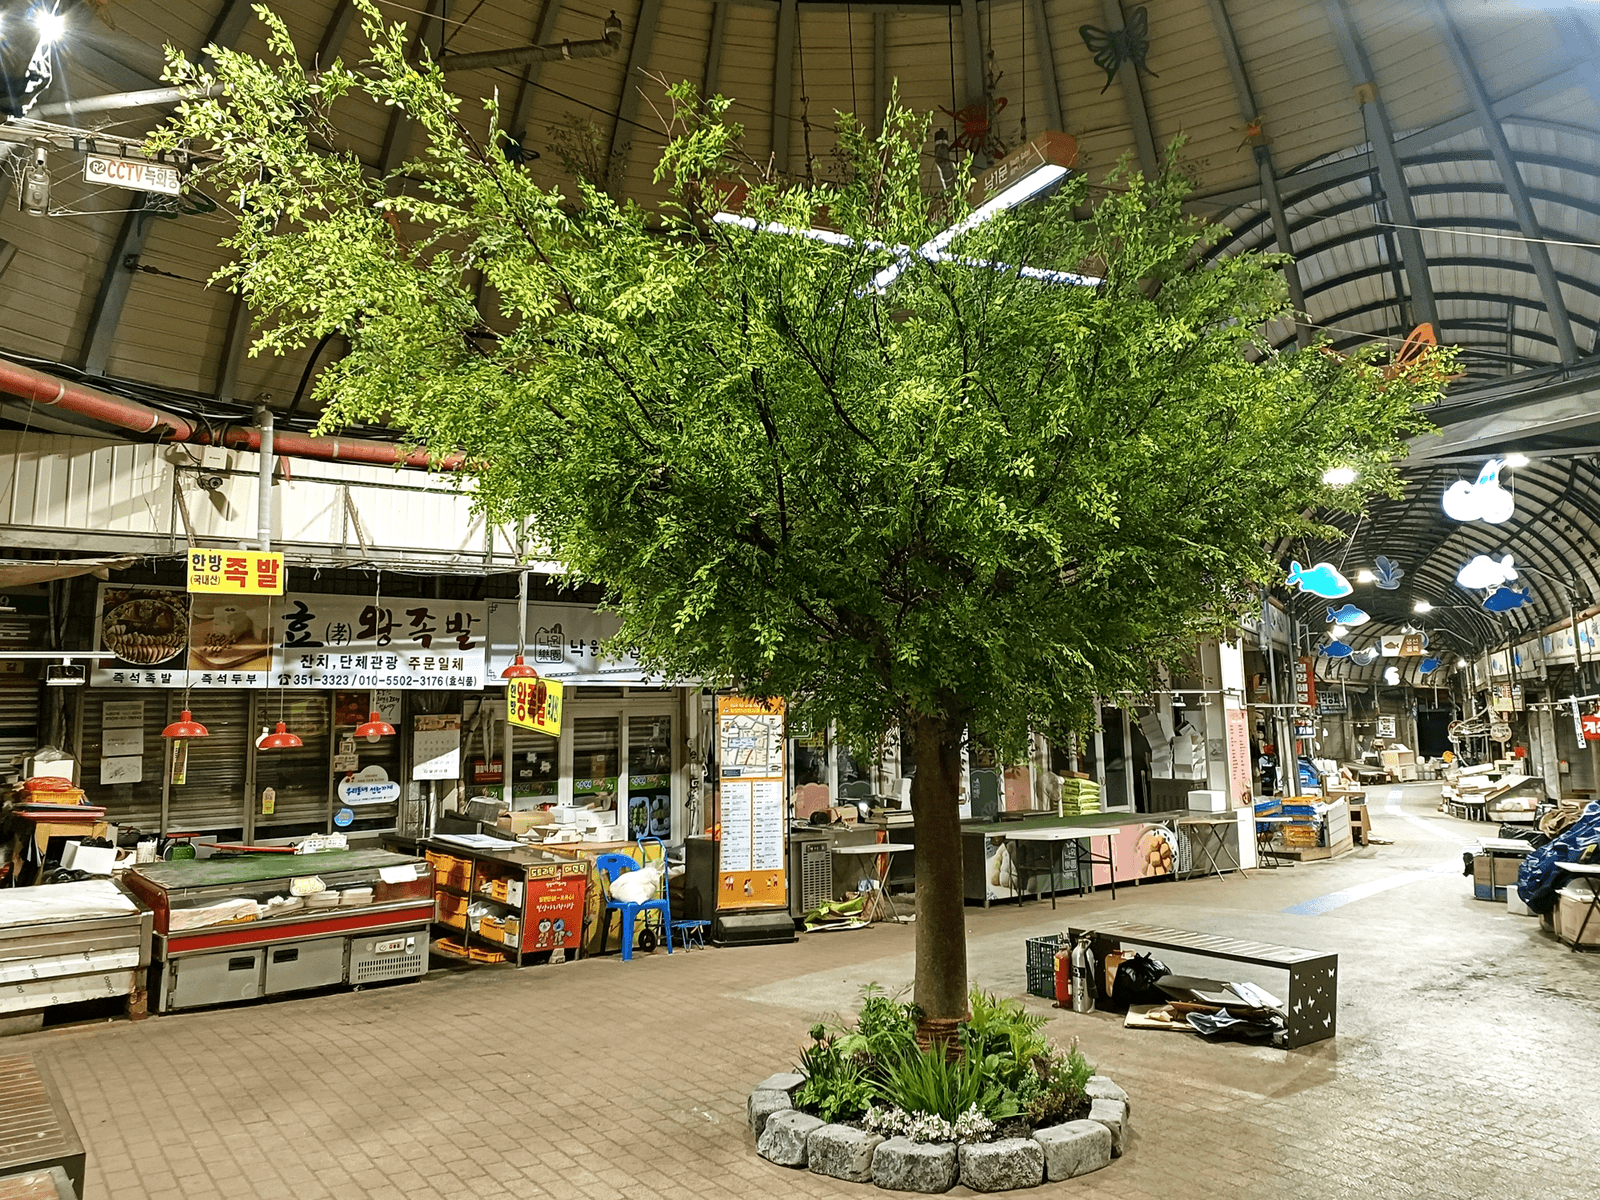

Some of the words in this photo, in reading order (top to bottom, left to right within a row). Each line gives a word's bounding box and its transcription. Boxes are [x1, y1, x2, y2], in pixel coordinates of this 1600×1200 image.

[192, 554, 222, 572] 한방
[190, 574, 221, 586] (국내산)
[224, 557, 279, 588] 족발
[408, 656, 464, 671] 주문일체
